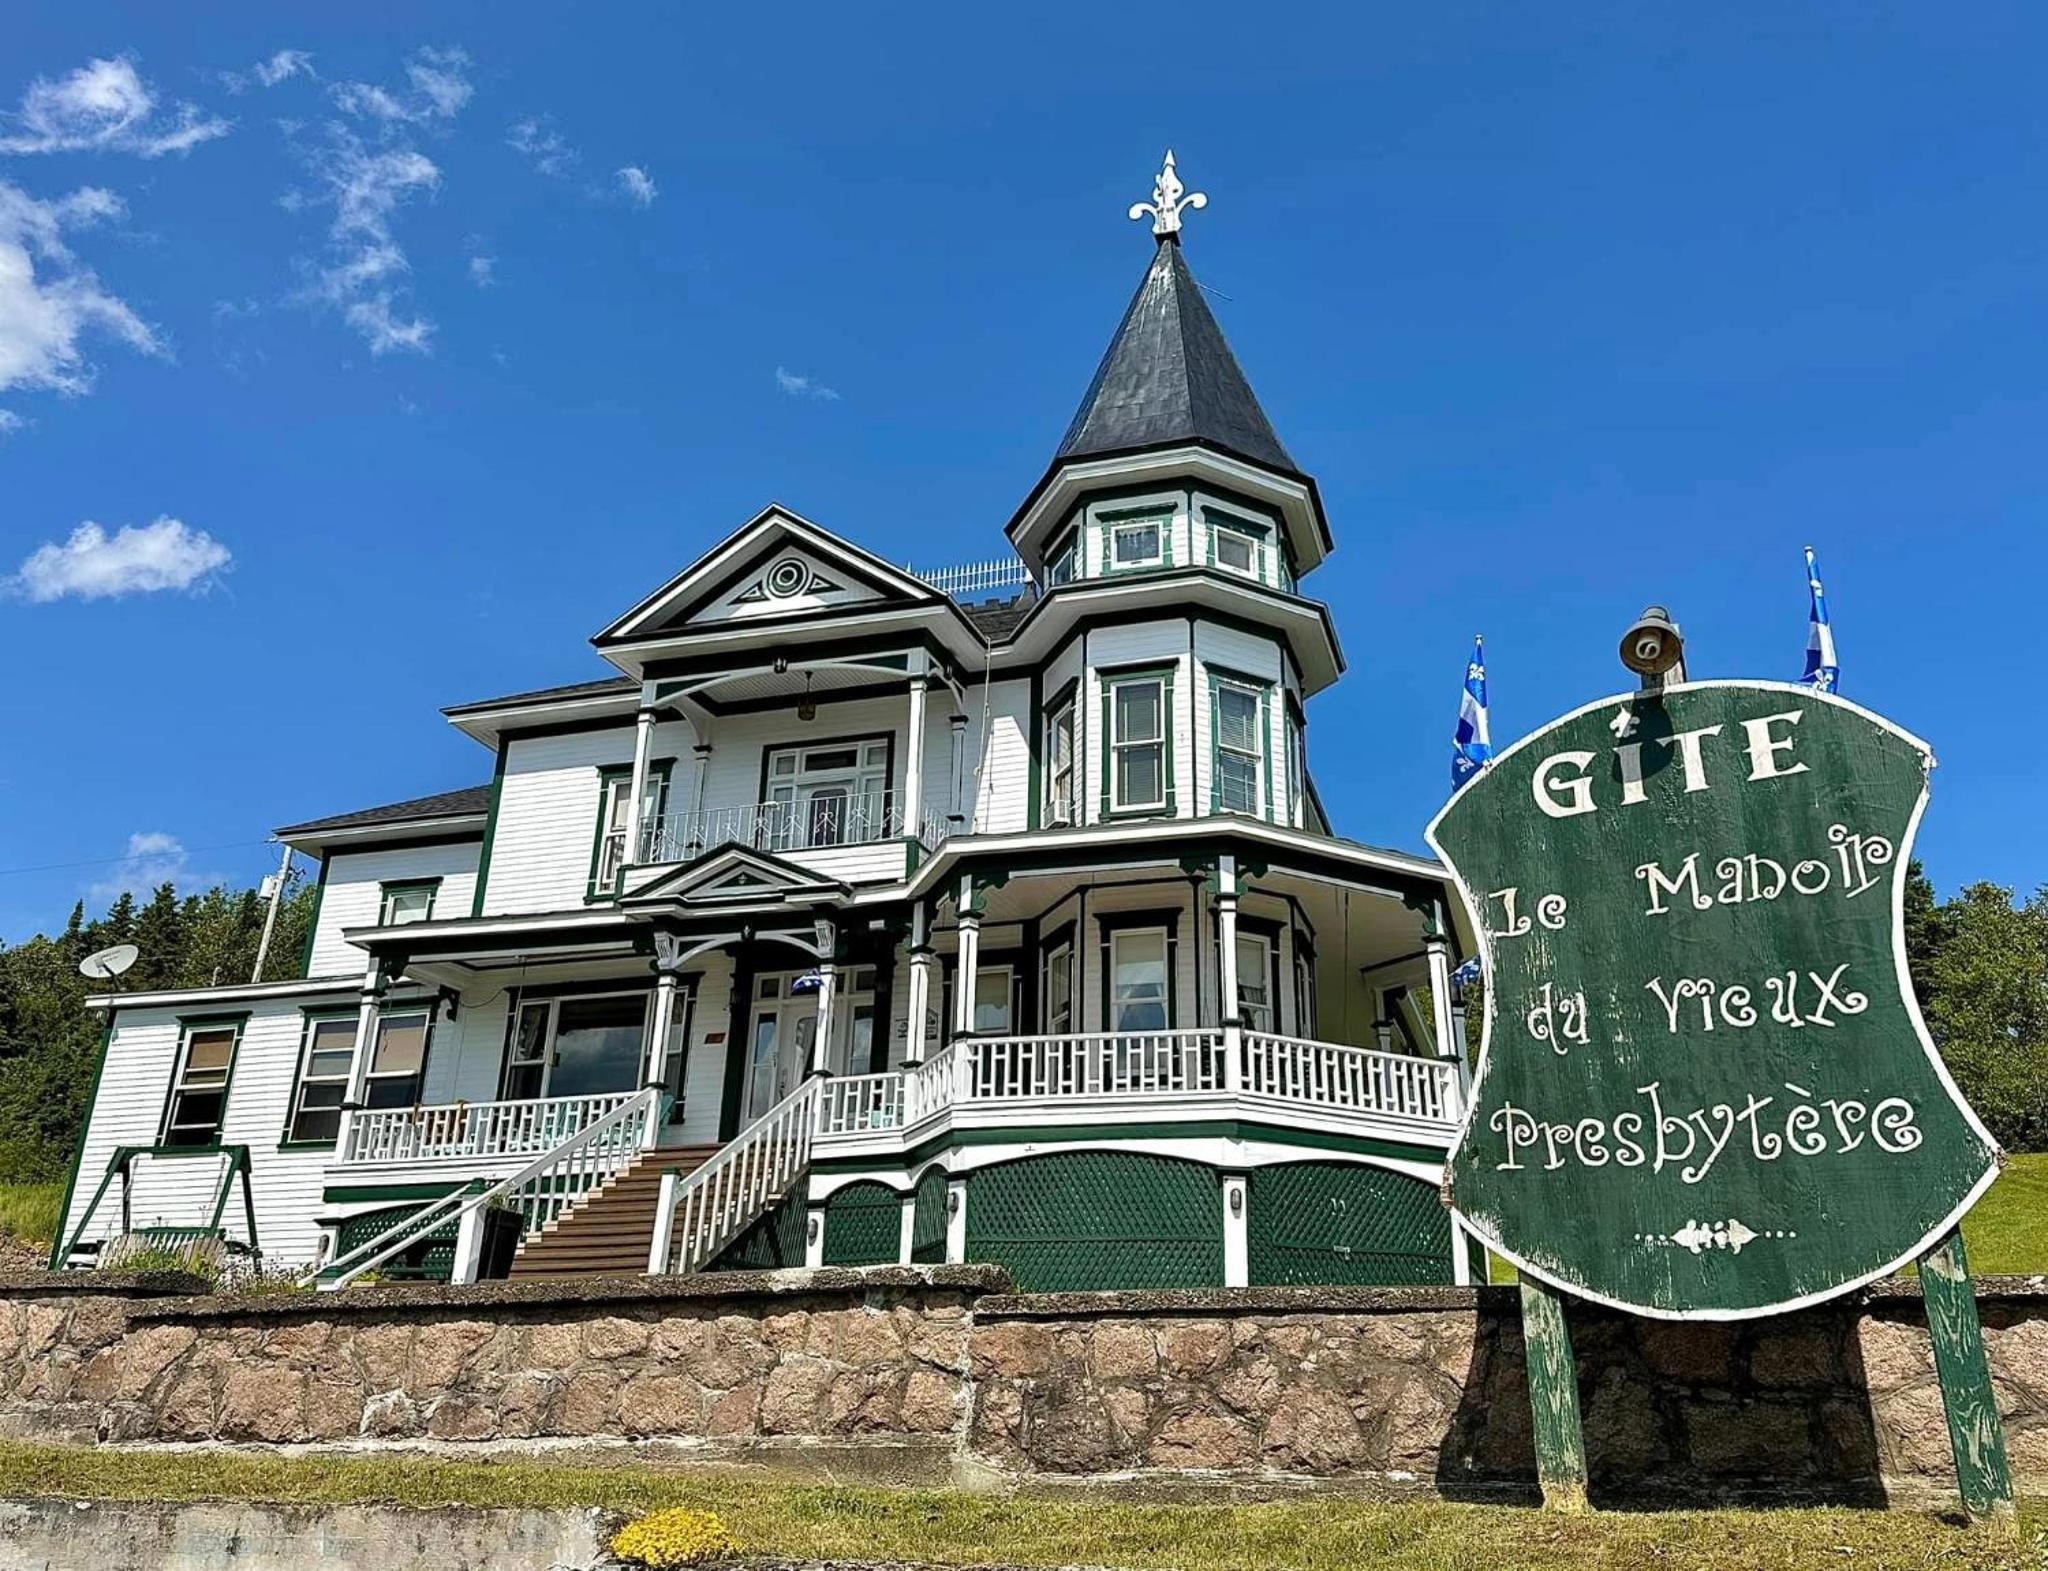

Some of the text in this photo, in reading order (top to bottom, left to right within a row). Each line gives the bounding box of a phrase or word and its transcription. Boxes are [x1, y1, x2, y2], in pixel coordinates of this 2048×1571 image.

[1488, 823, 1893, 938] Le Manoir
[1527, 982, 1591, 1055] du
[1489, 1081, 1923, 1184] Presbytère
